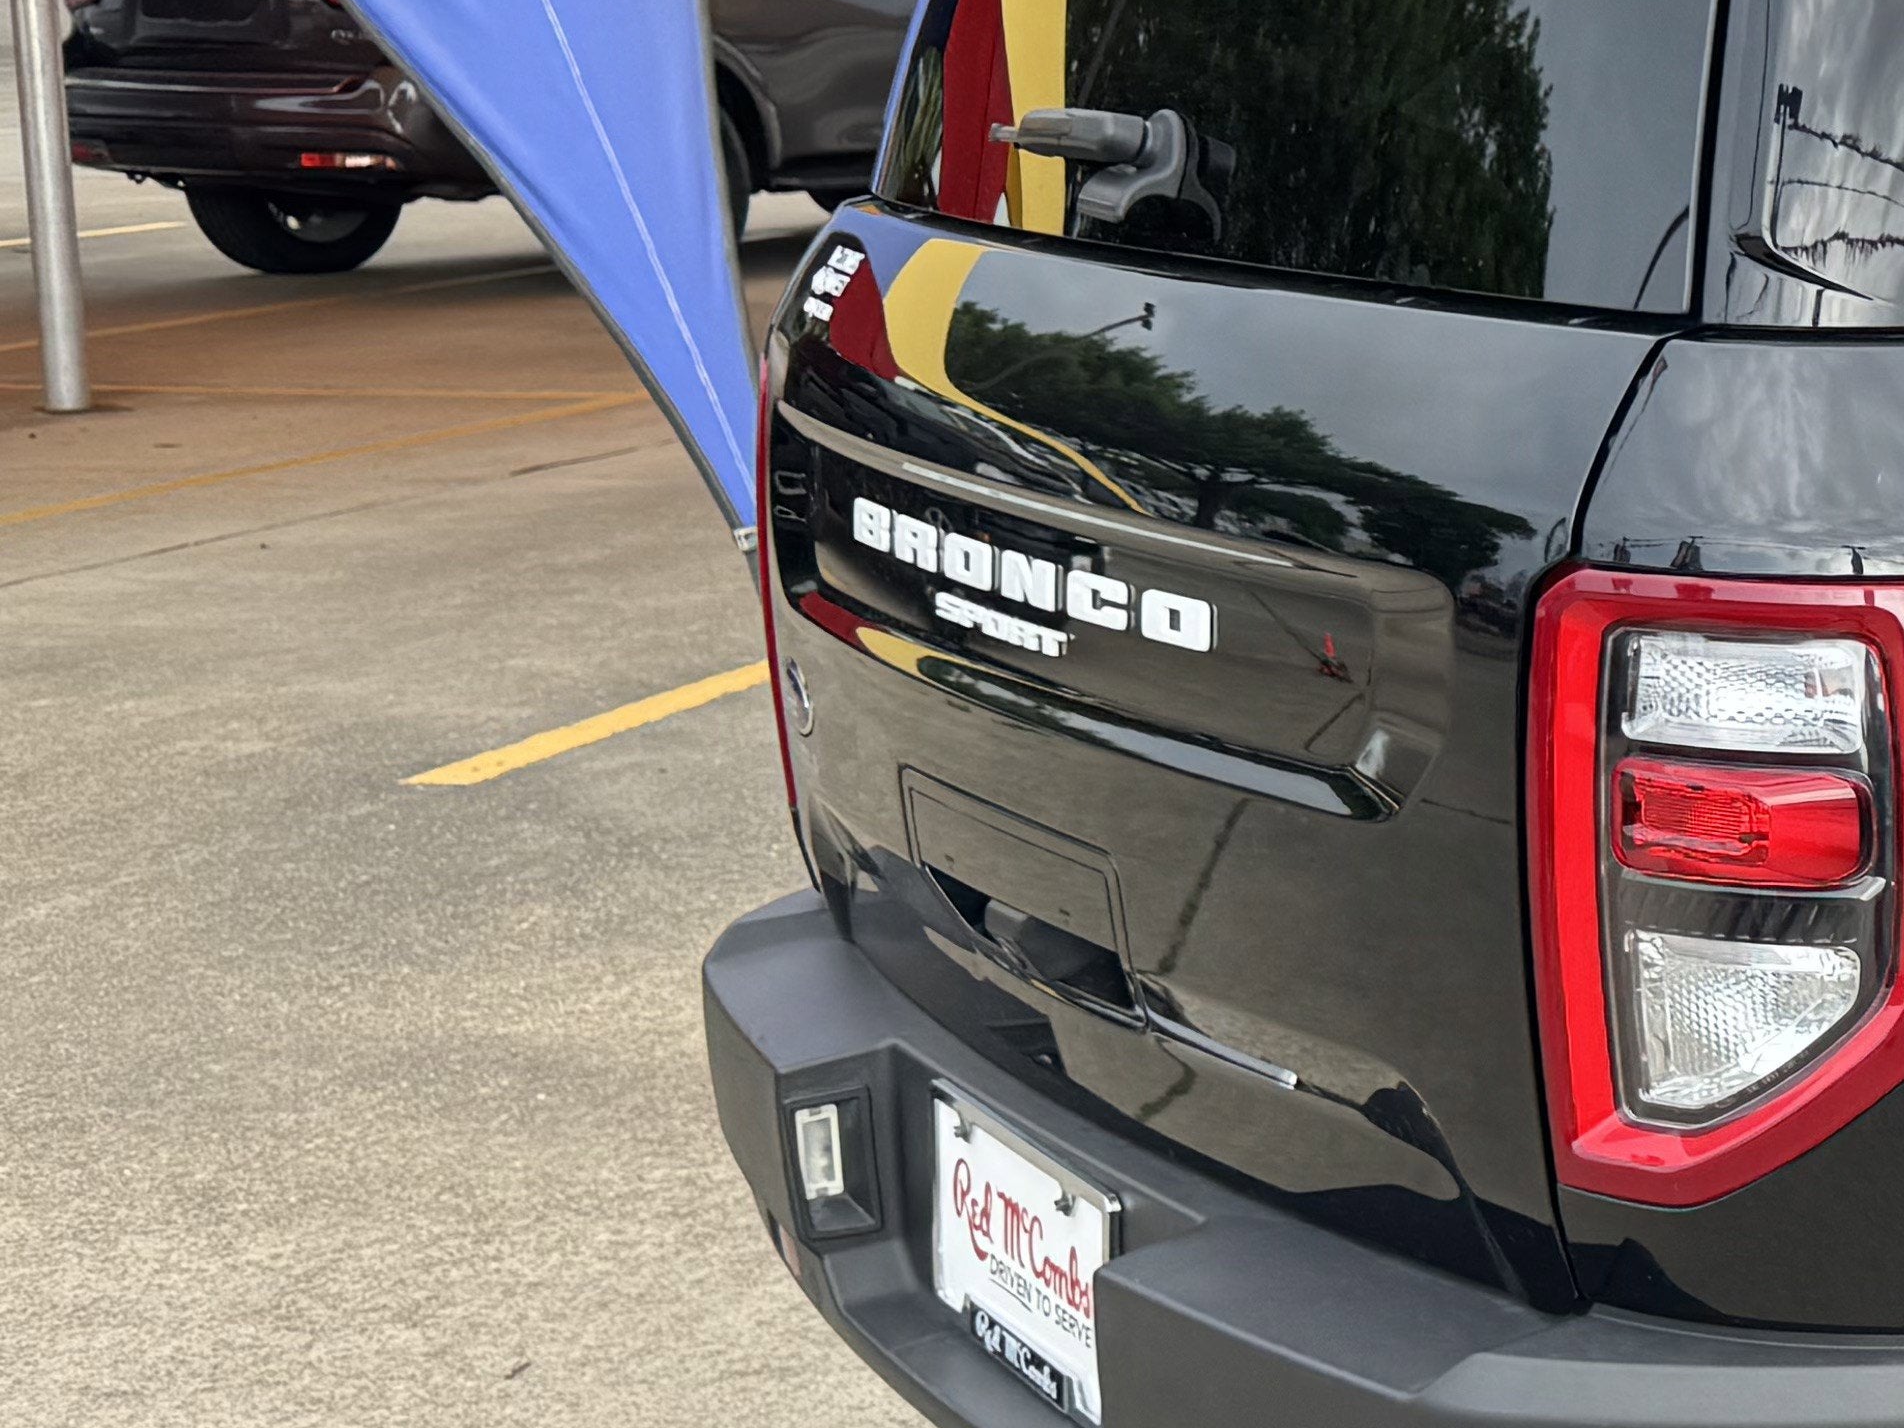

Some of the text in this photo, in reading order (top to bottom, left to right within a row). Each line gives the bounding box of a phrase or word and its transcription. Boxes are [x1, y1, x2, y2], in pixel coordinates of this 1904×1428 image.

[852, 496, 1217, 654] BRONCO
[934, 590, 1074, 658] SPORT
[952, 1157, 994, 1262] Red
[988, 1253, 1093, 1350] DRIVEN TO SERVE
